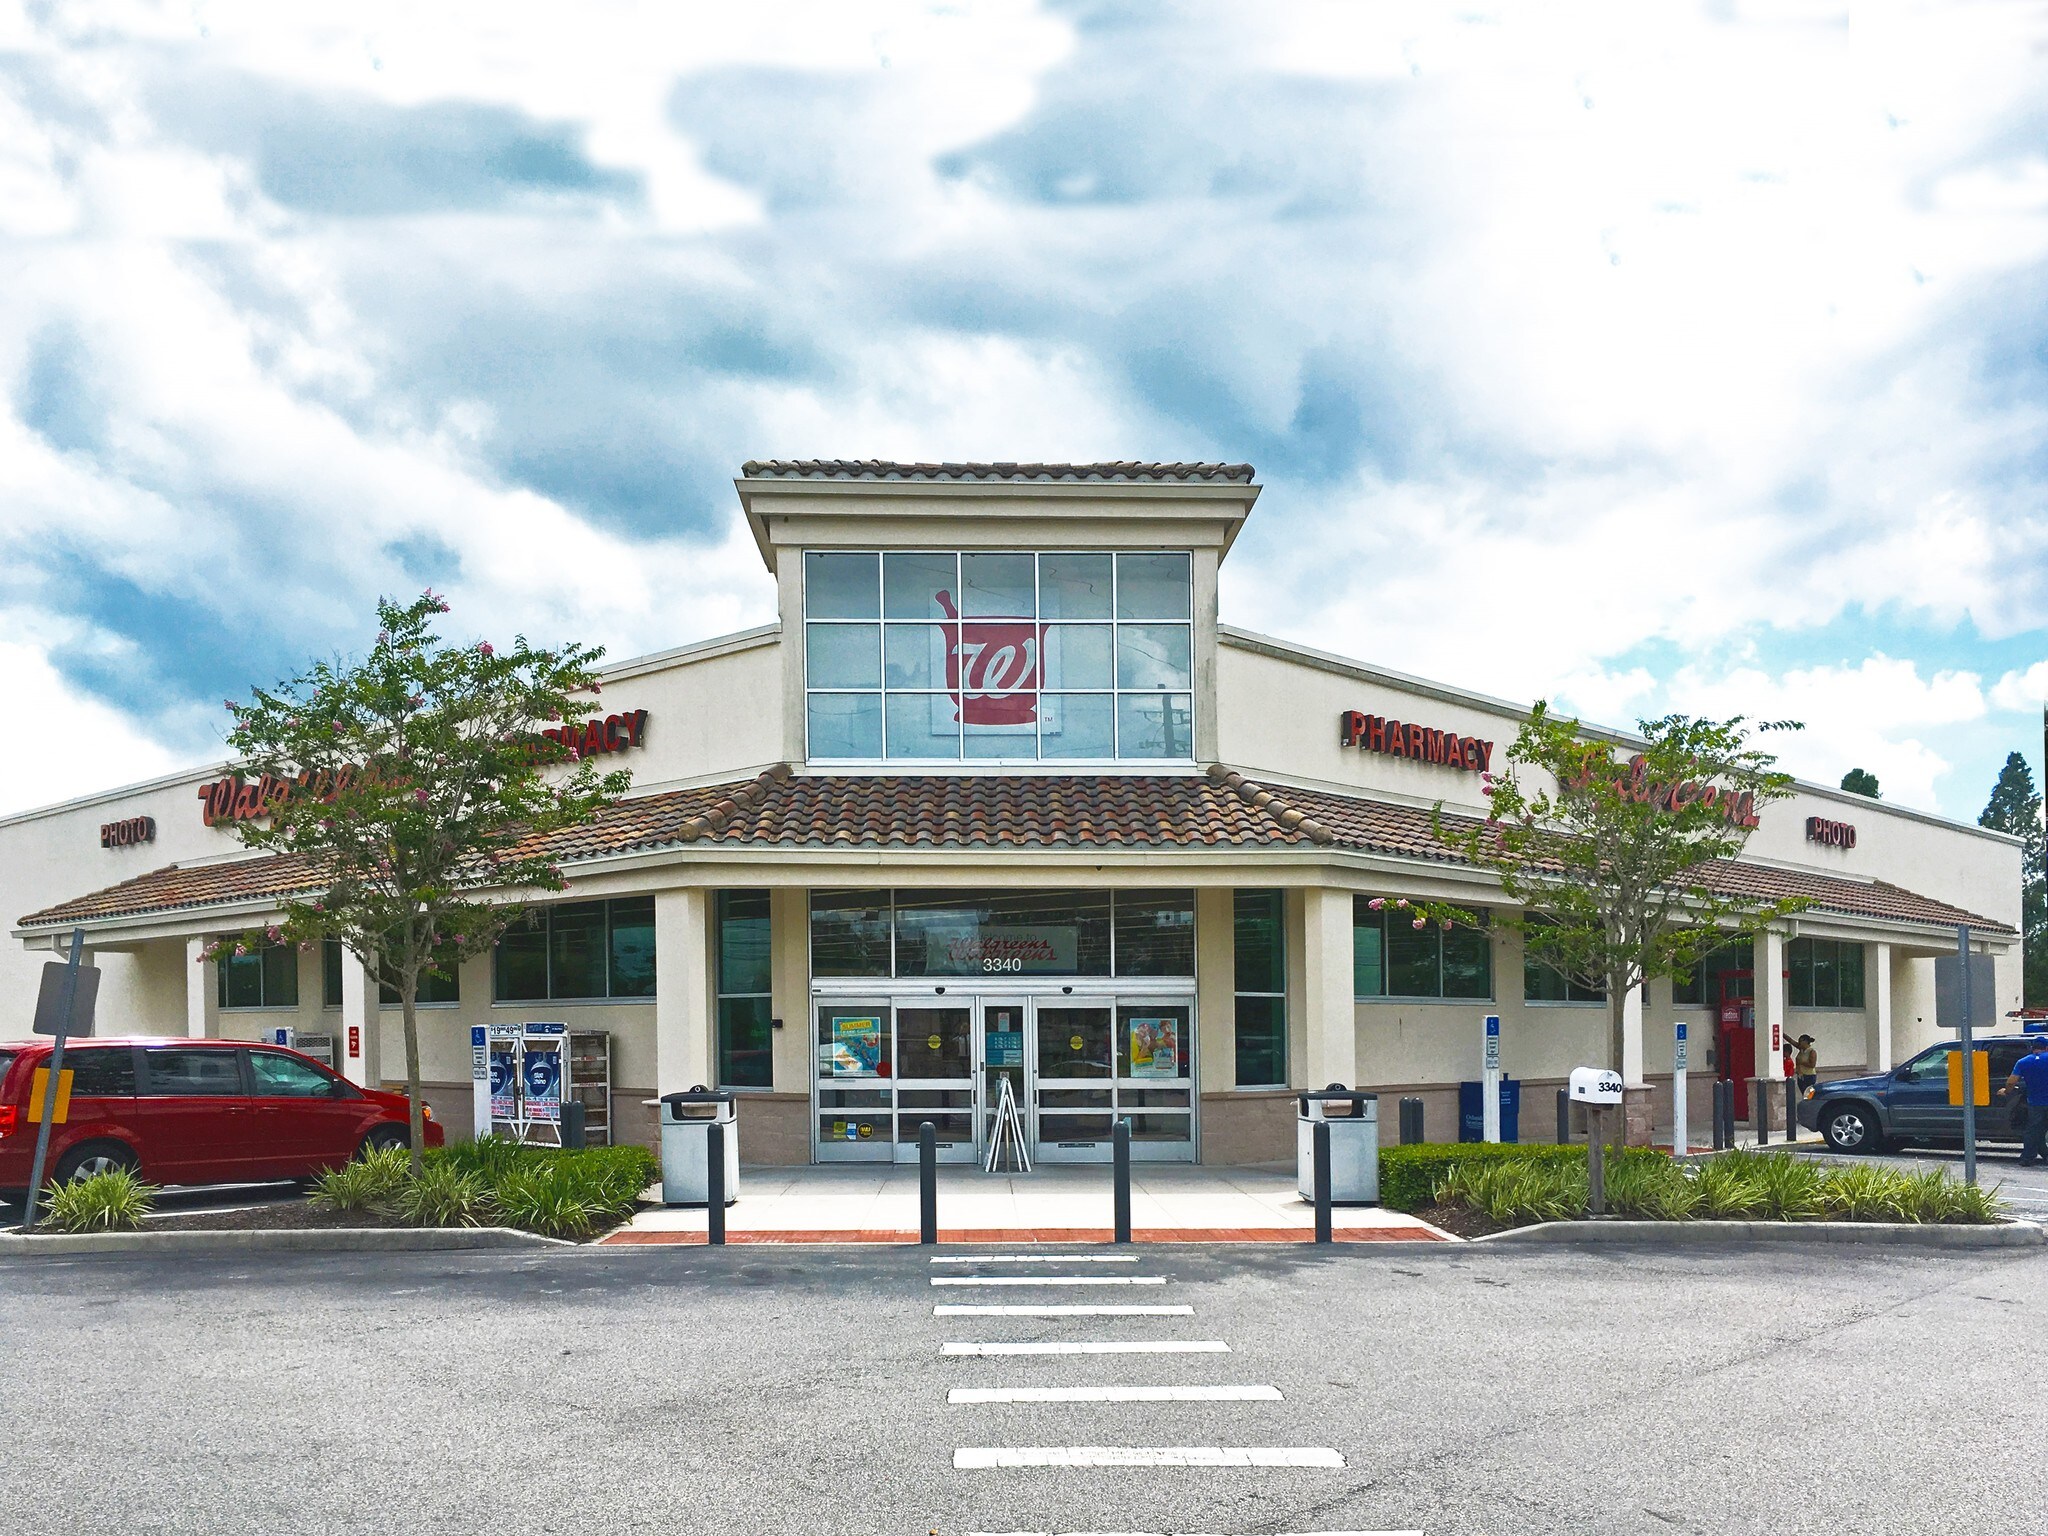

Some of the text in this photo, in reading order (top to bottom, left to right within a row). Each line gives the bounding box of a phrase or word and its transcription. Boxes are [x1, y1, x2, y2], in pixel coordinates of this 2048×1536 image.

[512, 709, 648, 767] MACY
[1341, 711, 1494, 773] PHARMACY
[101, 816, 154, 848] PHOTO
[1807, 817, 1856, 848] PHOTO
[983, 958, 1021, 971] 3340
[1598, 1082, 1622, 1093] 3340
